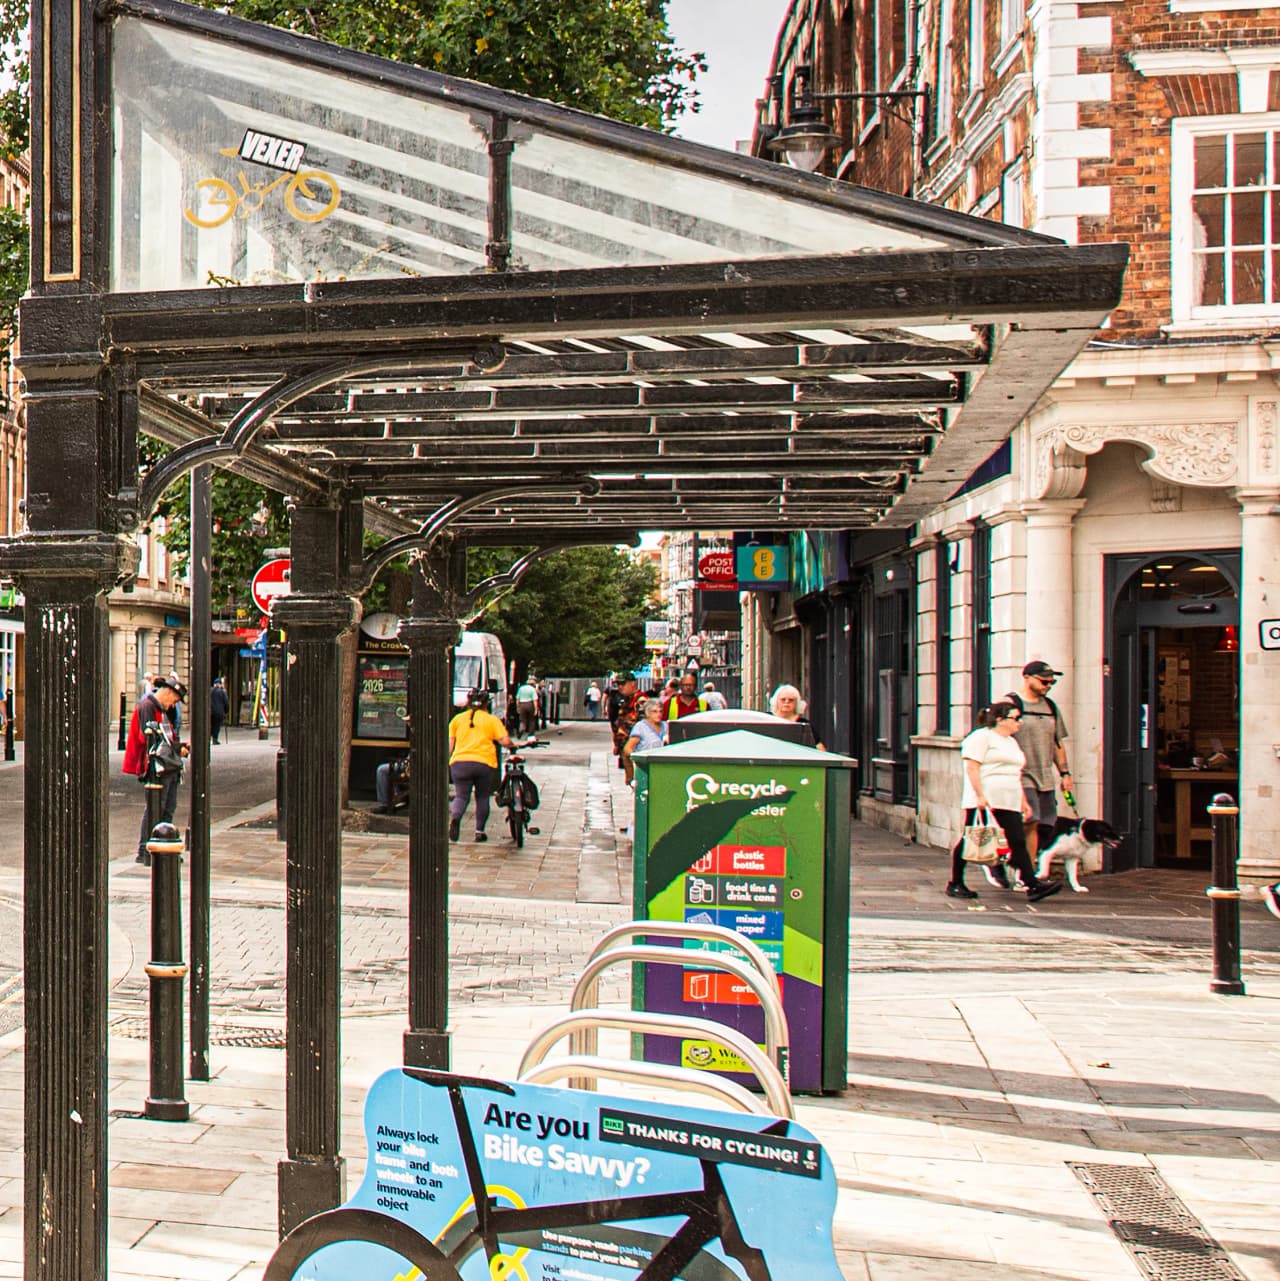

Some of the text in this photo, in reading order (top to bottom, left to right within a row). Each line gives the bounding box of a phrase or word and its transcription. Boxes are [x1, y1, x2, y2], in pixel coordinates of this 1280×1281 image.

[241, 131, 305, 171] VEXER
[709, 558, 733, 566] POST
[365, 641, 379, 649] The
[363, 679, 384, 692] 2026
[721, 779, 787, 799] recycle
[733, 850, 764, 861] plastic
[733, 860, 765, 870] bottles
[726, 882, 777, 893] food tins &
[727, 891, 776, 902] drink cans
[735, 914, 766, 924] mixed
[735, 926, 766, 935] paper
[731, 985, 756, 993] cart
[484, 1103, 590, 1140] Are you
[377, 1125, 439, 1145] Always lock
[377, 1141, 426, 1158] your bike
[627, 1123, 799, 1164] THANKS FOR CYCLING!
[375, 1153, 459, 1179] frame and both
[484, 1134, 651, 1188] Bike Savvy?
[376, 1169, 443, 1188] wheels to an
[377, 1181, 436, 1202] immovable
[377, 1197, 409, 1211] object
[542, 1230, 653, 1260] Use purpose-made parking
[542, 1243, 640, 1268] stands to park your bike
[542, 1264, 560, 1273] Visit
